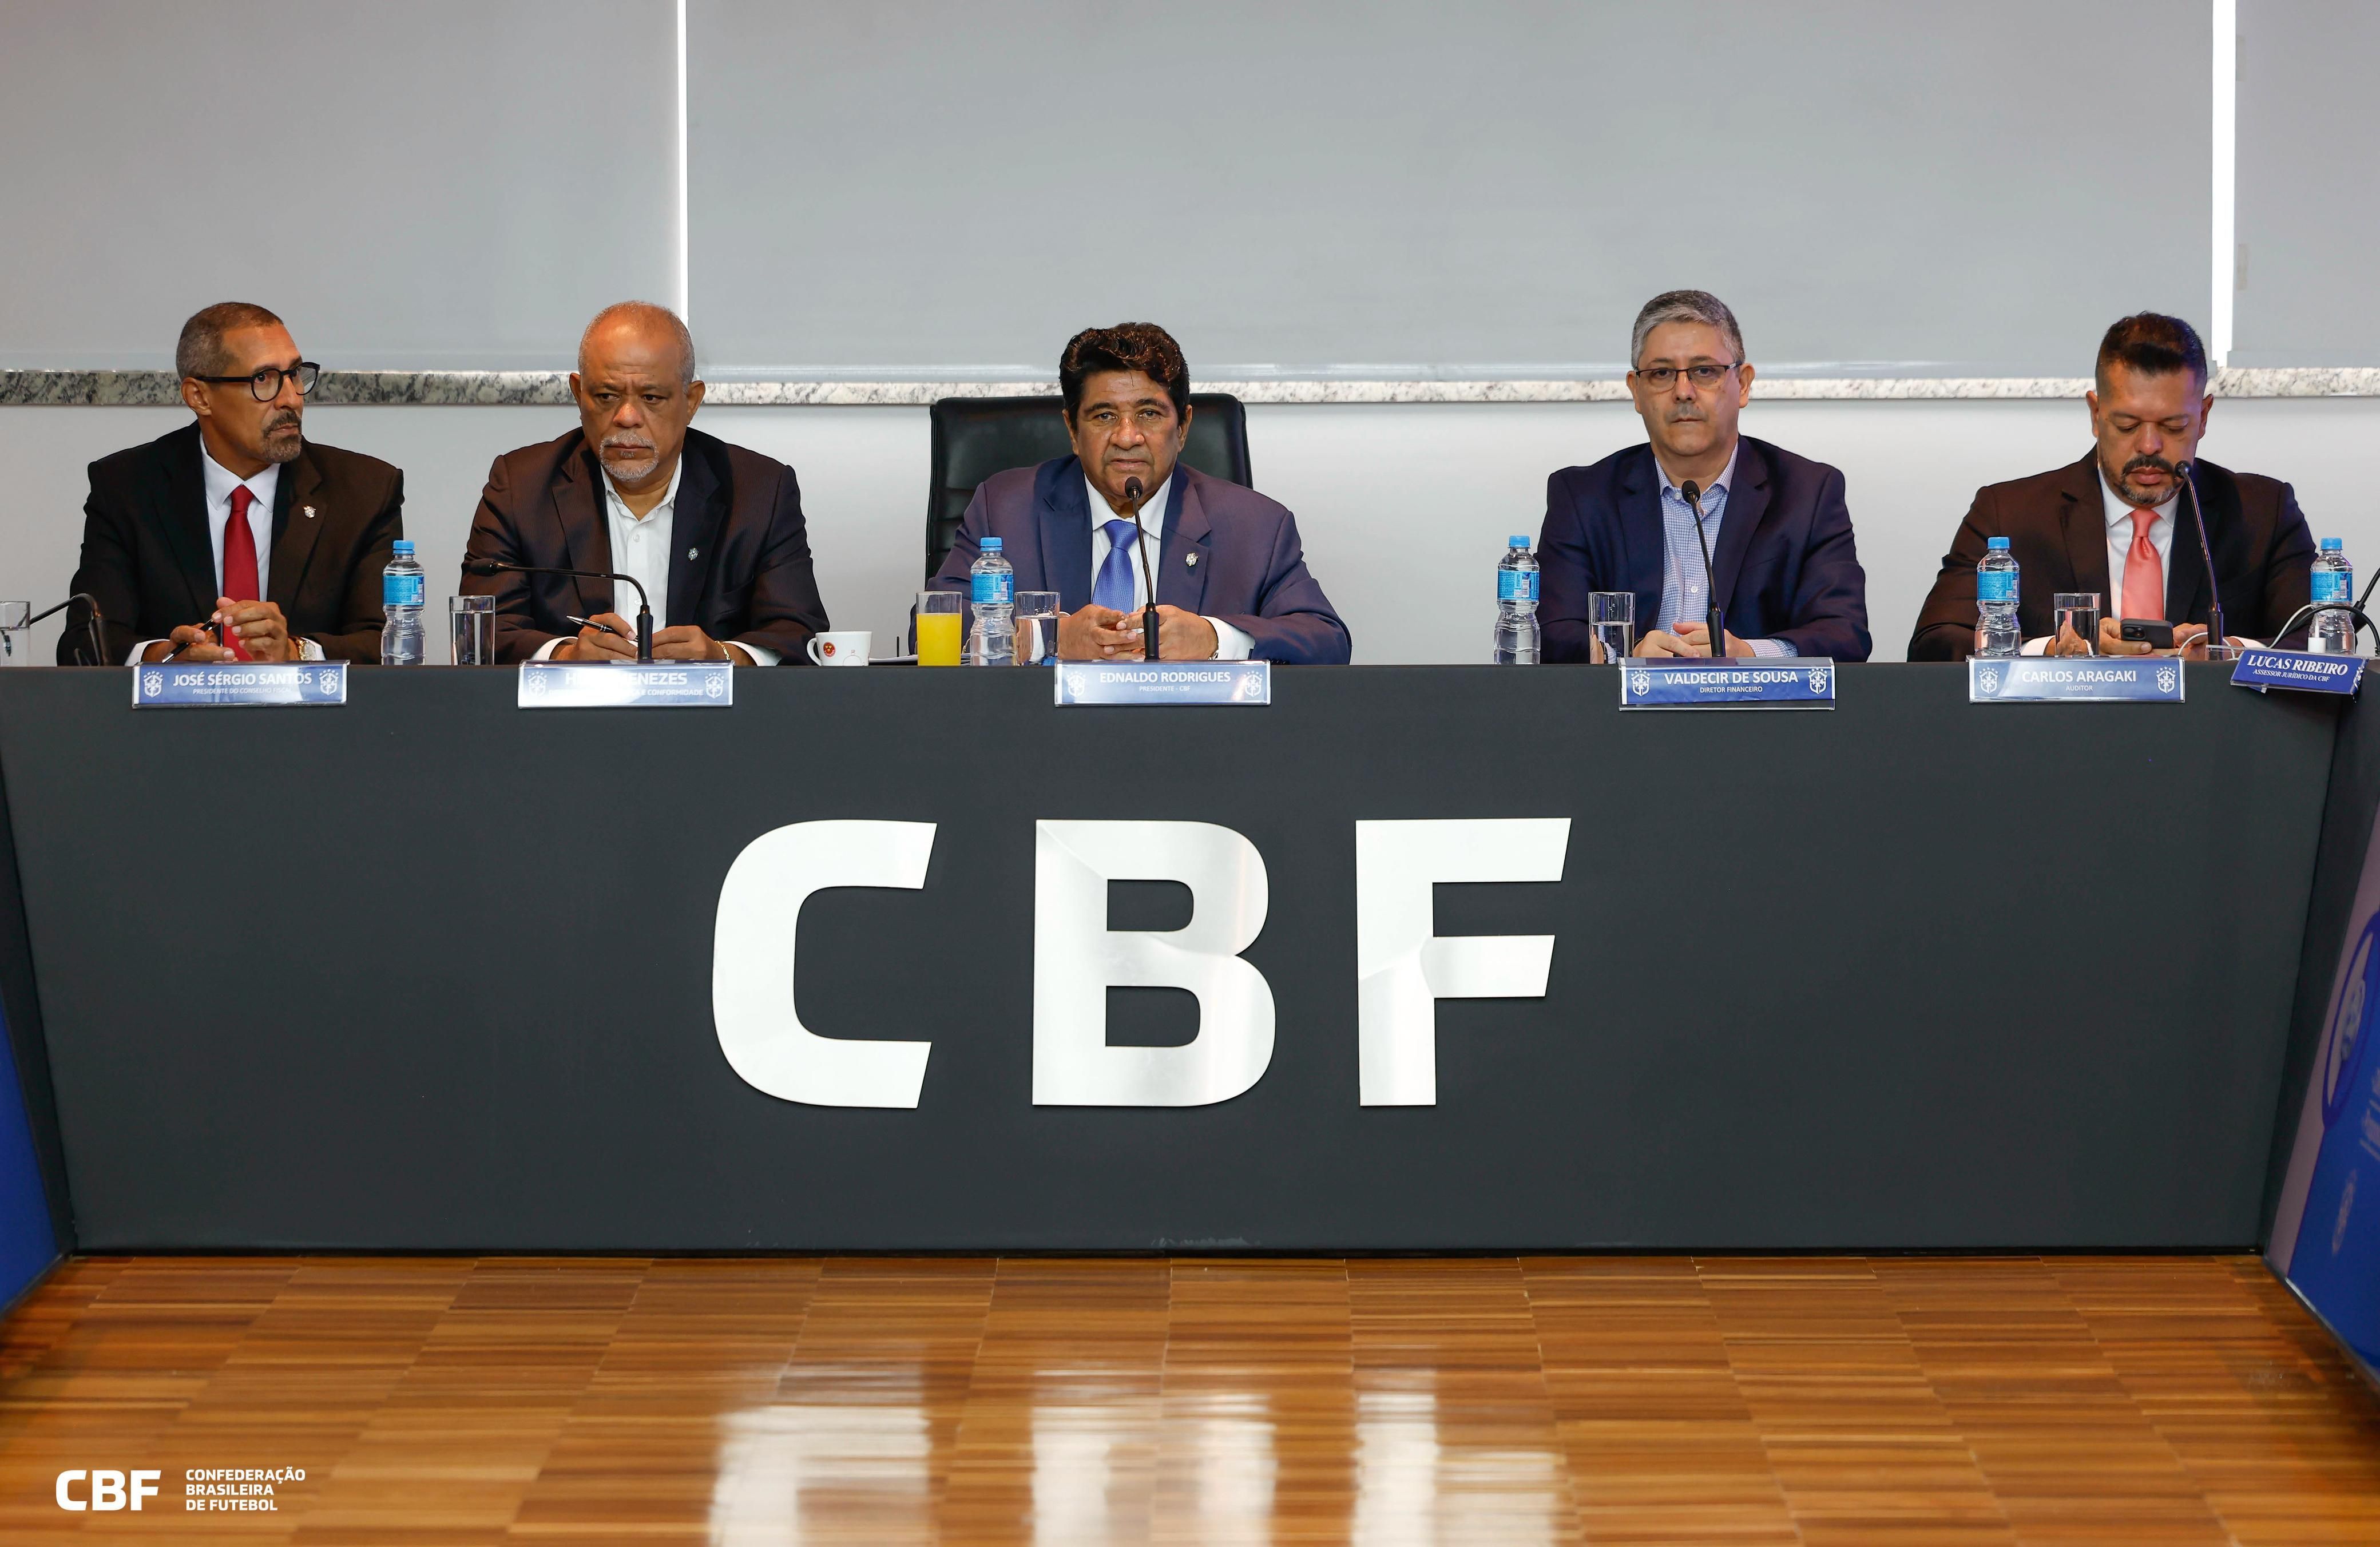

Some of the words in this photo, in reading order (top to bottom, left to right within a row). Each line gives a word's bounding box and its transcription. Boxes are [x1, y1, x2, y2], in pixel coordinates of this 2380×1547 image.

[2247, 654, 2292, 670] LUCAS
[2292, 659, 2349, 676] RIBEIRO
[173, 671, 205, 687] JOSÉ
[207, 671, 256, 686] SÉRGIO
[259, 672, 312, 685] SANTOS
[618, 672, 688, 685] ENEZES
[1100, 672, 1158, 684] EDNALDO
[1161, 672, 1231, 683] RODRIGUES
[1664, 672, 1729, 685] VALDECIR
[1732, 672, 1749, 684] DE
[1752, 671, 1799, 684] SOUSA
[2021, 671, 2073, 683] CARLOS
[2076, 670, 2137, 683] ARAGAKI
[2252, 669, 2282, 677] ASSESSOR
[2280, 671, 2308, 680] JURÍDICO
[712, 818, 1572, 1109] CBF
